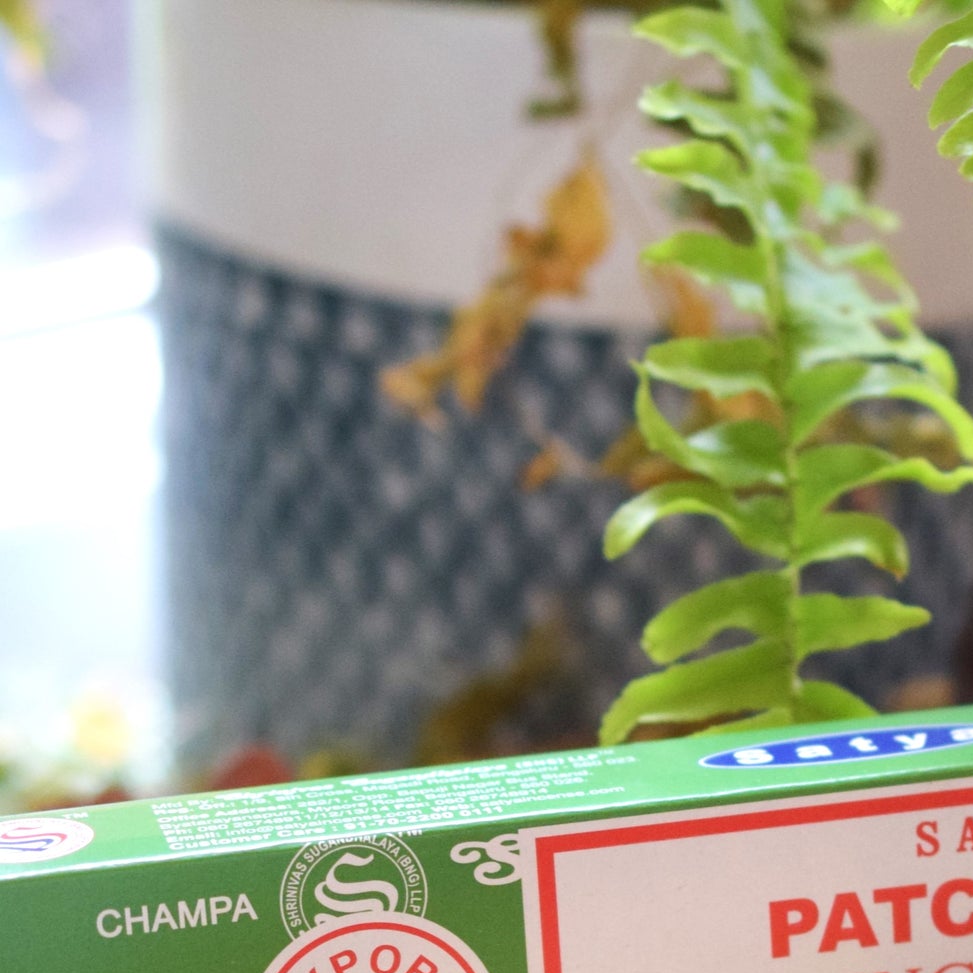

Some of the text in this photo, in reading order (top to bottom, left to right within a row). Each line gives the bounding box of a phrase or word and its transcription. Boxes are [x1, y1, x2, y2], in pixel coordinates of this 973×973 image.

[167, 831, 273, 850] Customer
[275, 825, 326, 838] Care
[96, 893, 258, 938] CHAMPA
[286, 861, 307, 928] SHRINIVAS
